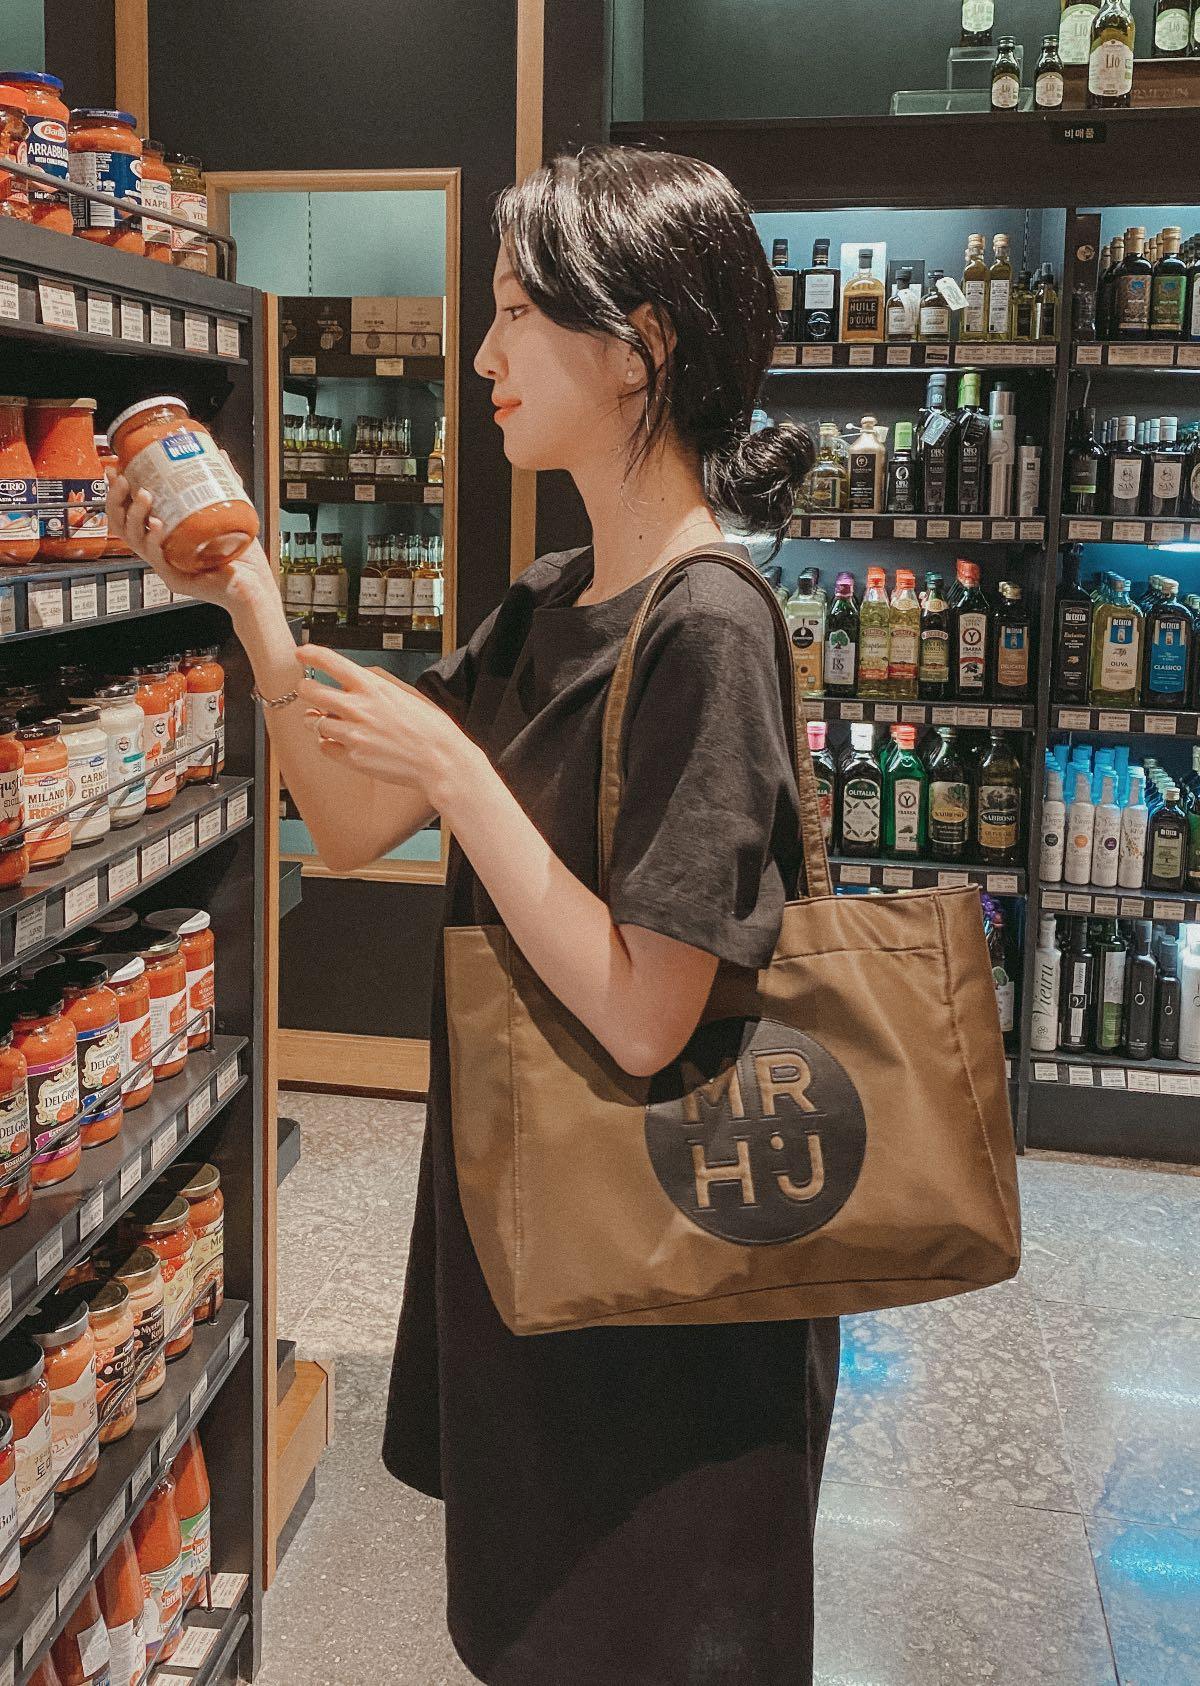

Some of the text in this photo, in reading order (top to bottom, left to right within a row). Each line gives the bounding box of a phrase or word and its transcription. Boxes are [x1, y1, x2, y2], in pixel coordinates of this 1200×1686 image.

[1105, 54, 1120, 69] Lio
[1064, 127, 1095, 139] 비매품
[850, 302, 876, 312] HUILE
[28, 789, 65, 804] MILANO
[848, 789, 876, 797] OLITALIA
[982, 814, 1015, 822] SABROSO
